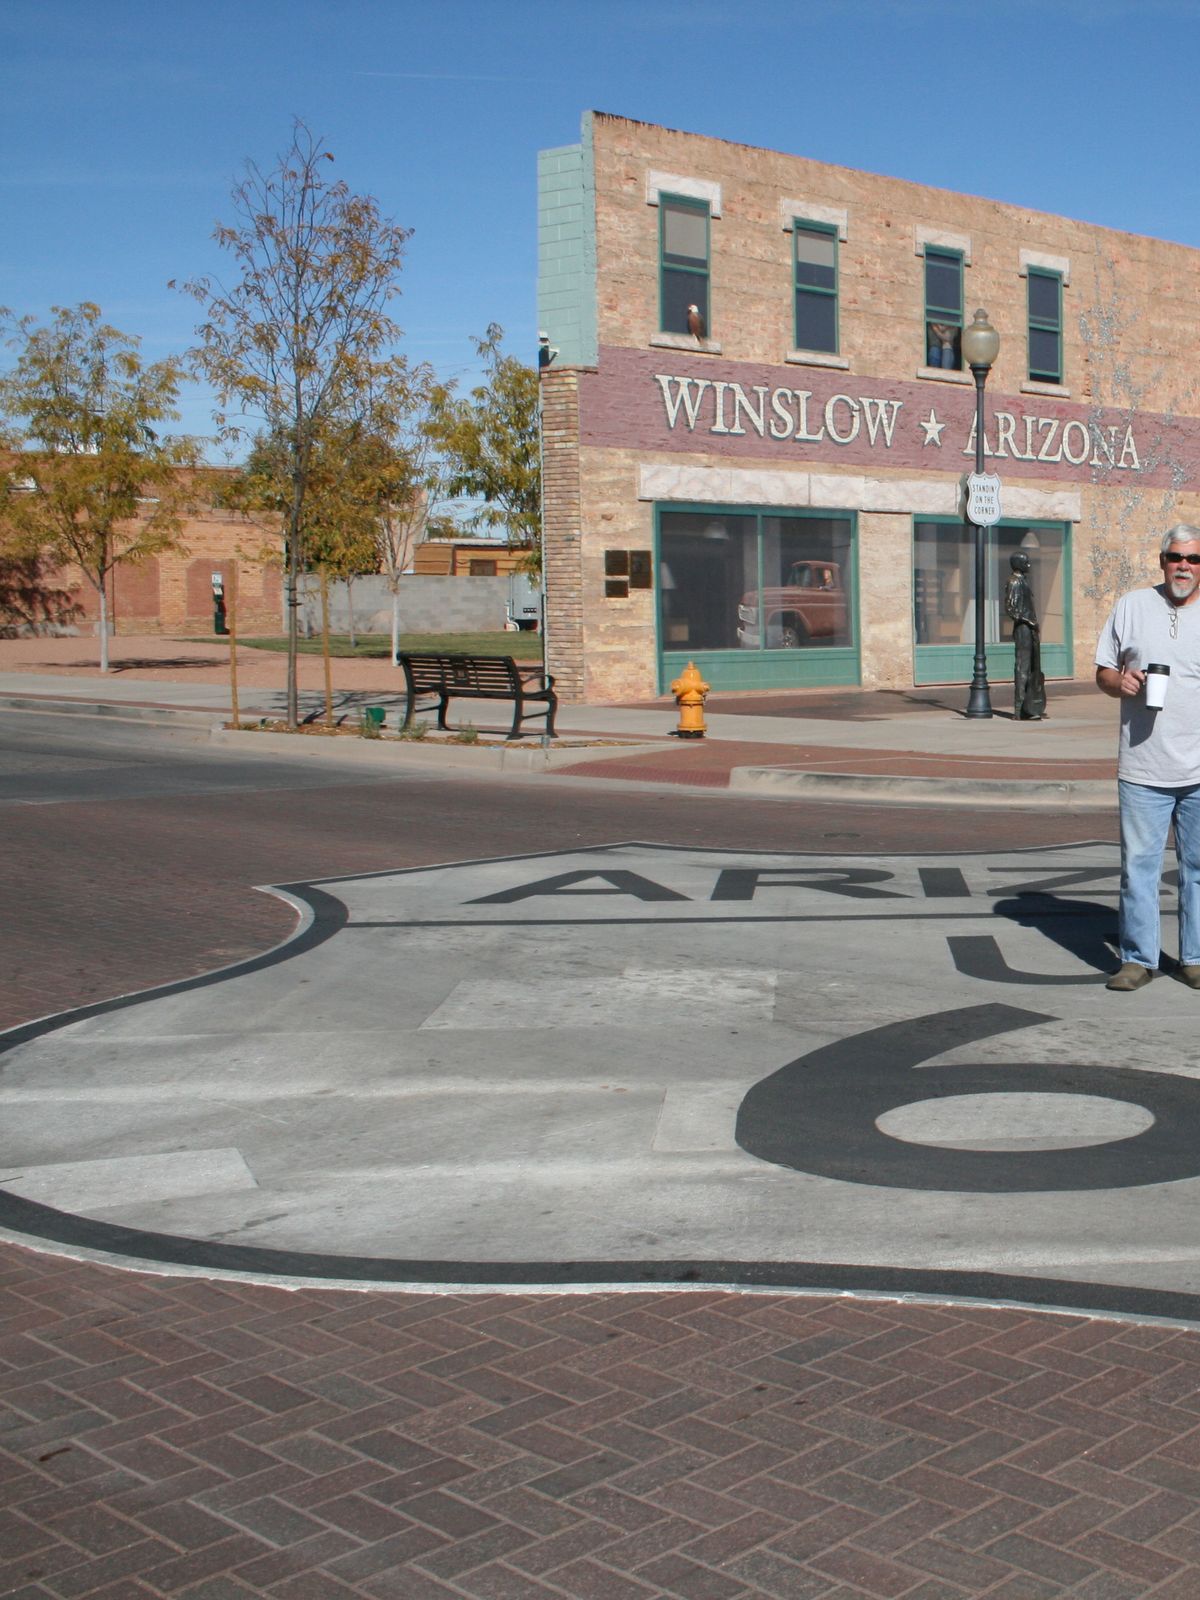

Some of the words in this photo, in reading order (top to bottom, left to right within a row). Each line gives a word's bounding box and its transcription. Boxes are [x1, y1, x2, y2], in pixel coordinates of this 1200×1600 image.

[655, 374, 903, 448] WINSLOW
[963, 410, 1140, 469] ARIZONA
[975, 496, 983, 504] ON
[984, 496, 994, 504] THE
[975, 506, 995, 515] CORNER
